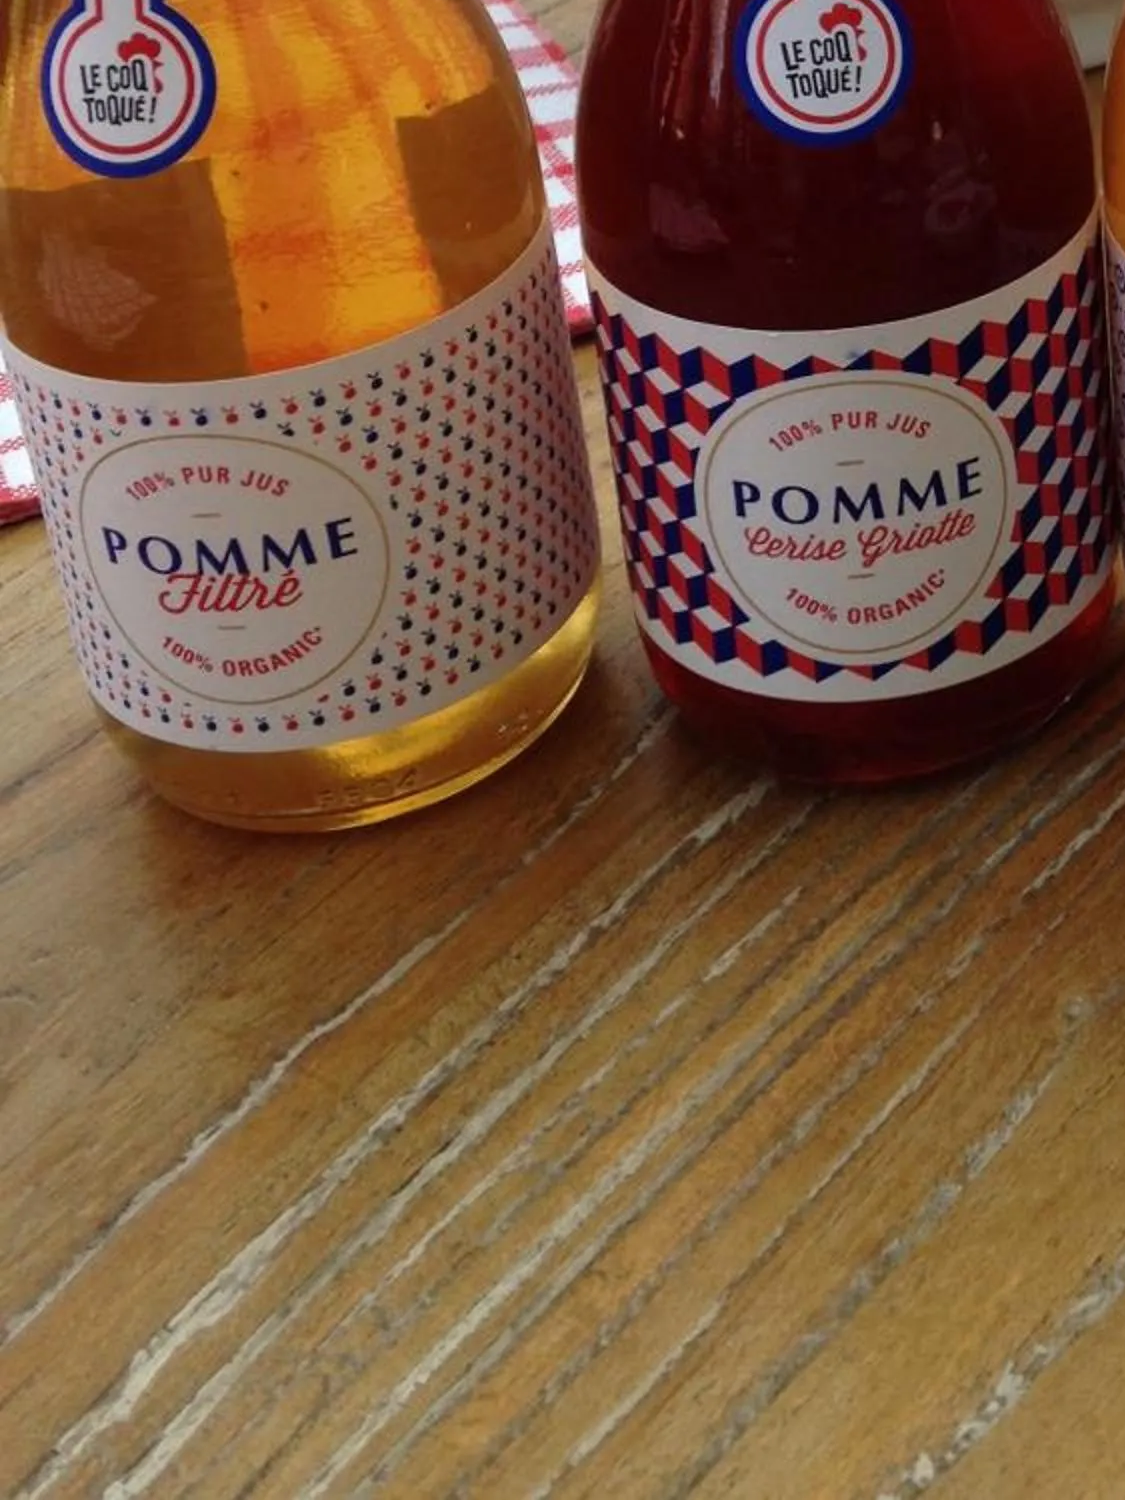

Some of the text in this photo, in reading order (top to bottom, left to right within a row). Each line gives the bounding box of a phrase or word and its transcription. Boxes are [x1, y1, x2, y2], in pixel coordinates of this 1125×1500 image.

[780, 31, 853, 71] LE COQ
[80, 59, 148, 94] LE COQ
[769, 410, 931, 452] 100% PUR JUS
[125, 466, 290, 500] 100% PUR JUS
[732, 456, 983, 524] POMME
[101, 516, 358, 576] POMME
[744, 508, 976, 569] Cerise Griotte
[158, 569, 303, 615] Filtré
[785, 587, 838, 622] 100%
[162, 636, 214, 674] 100%
